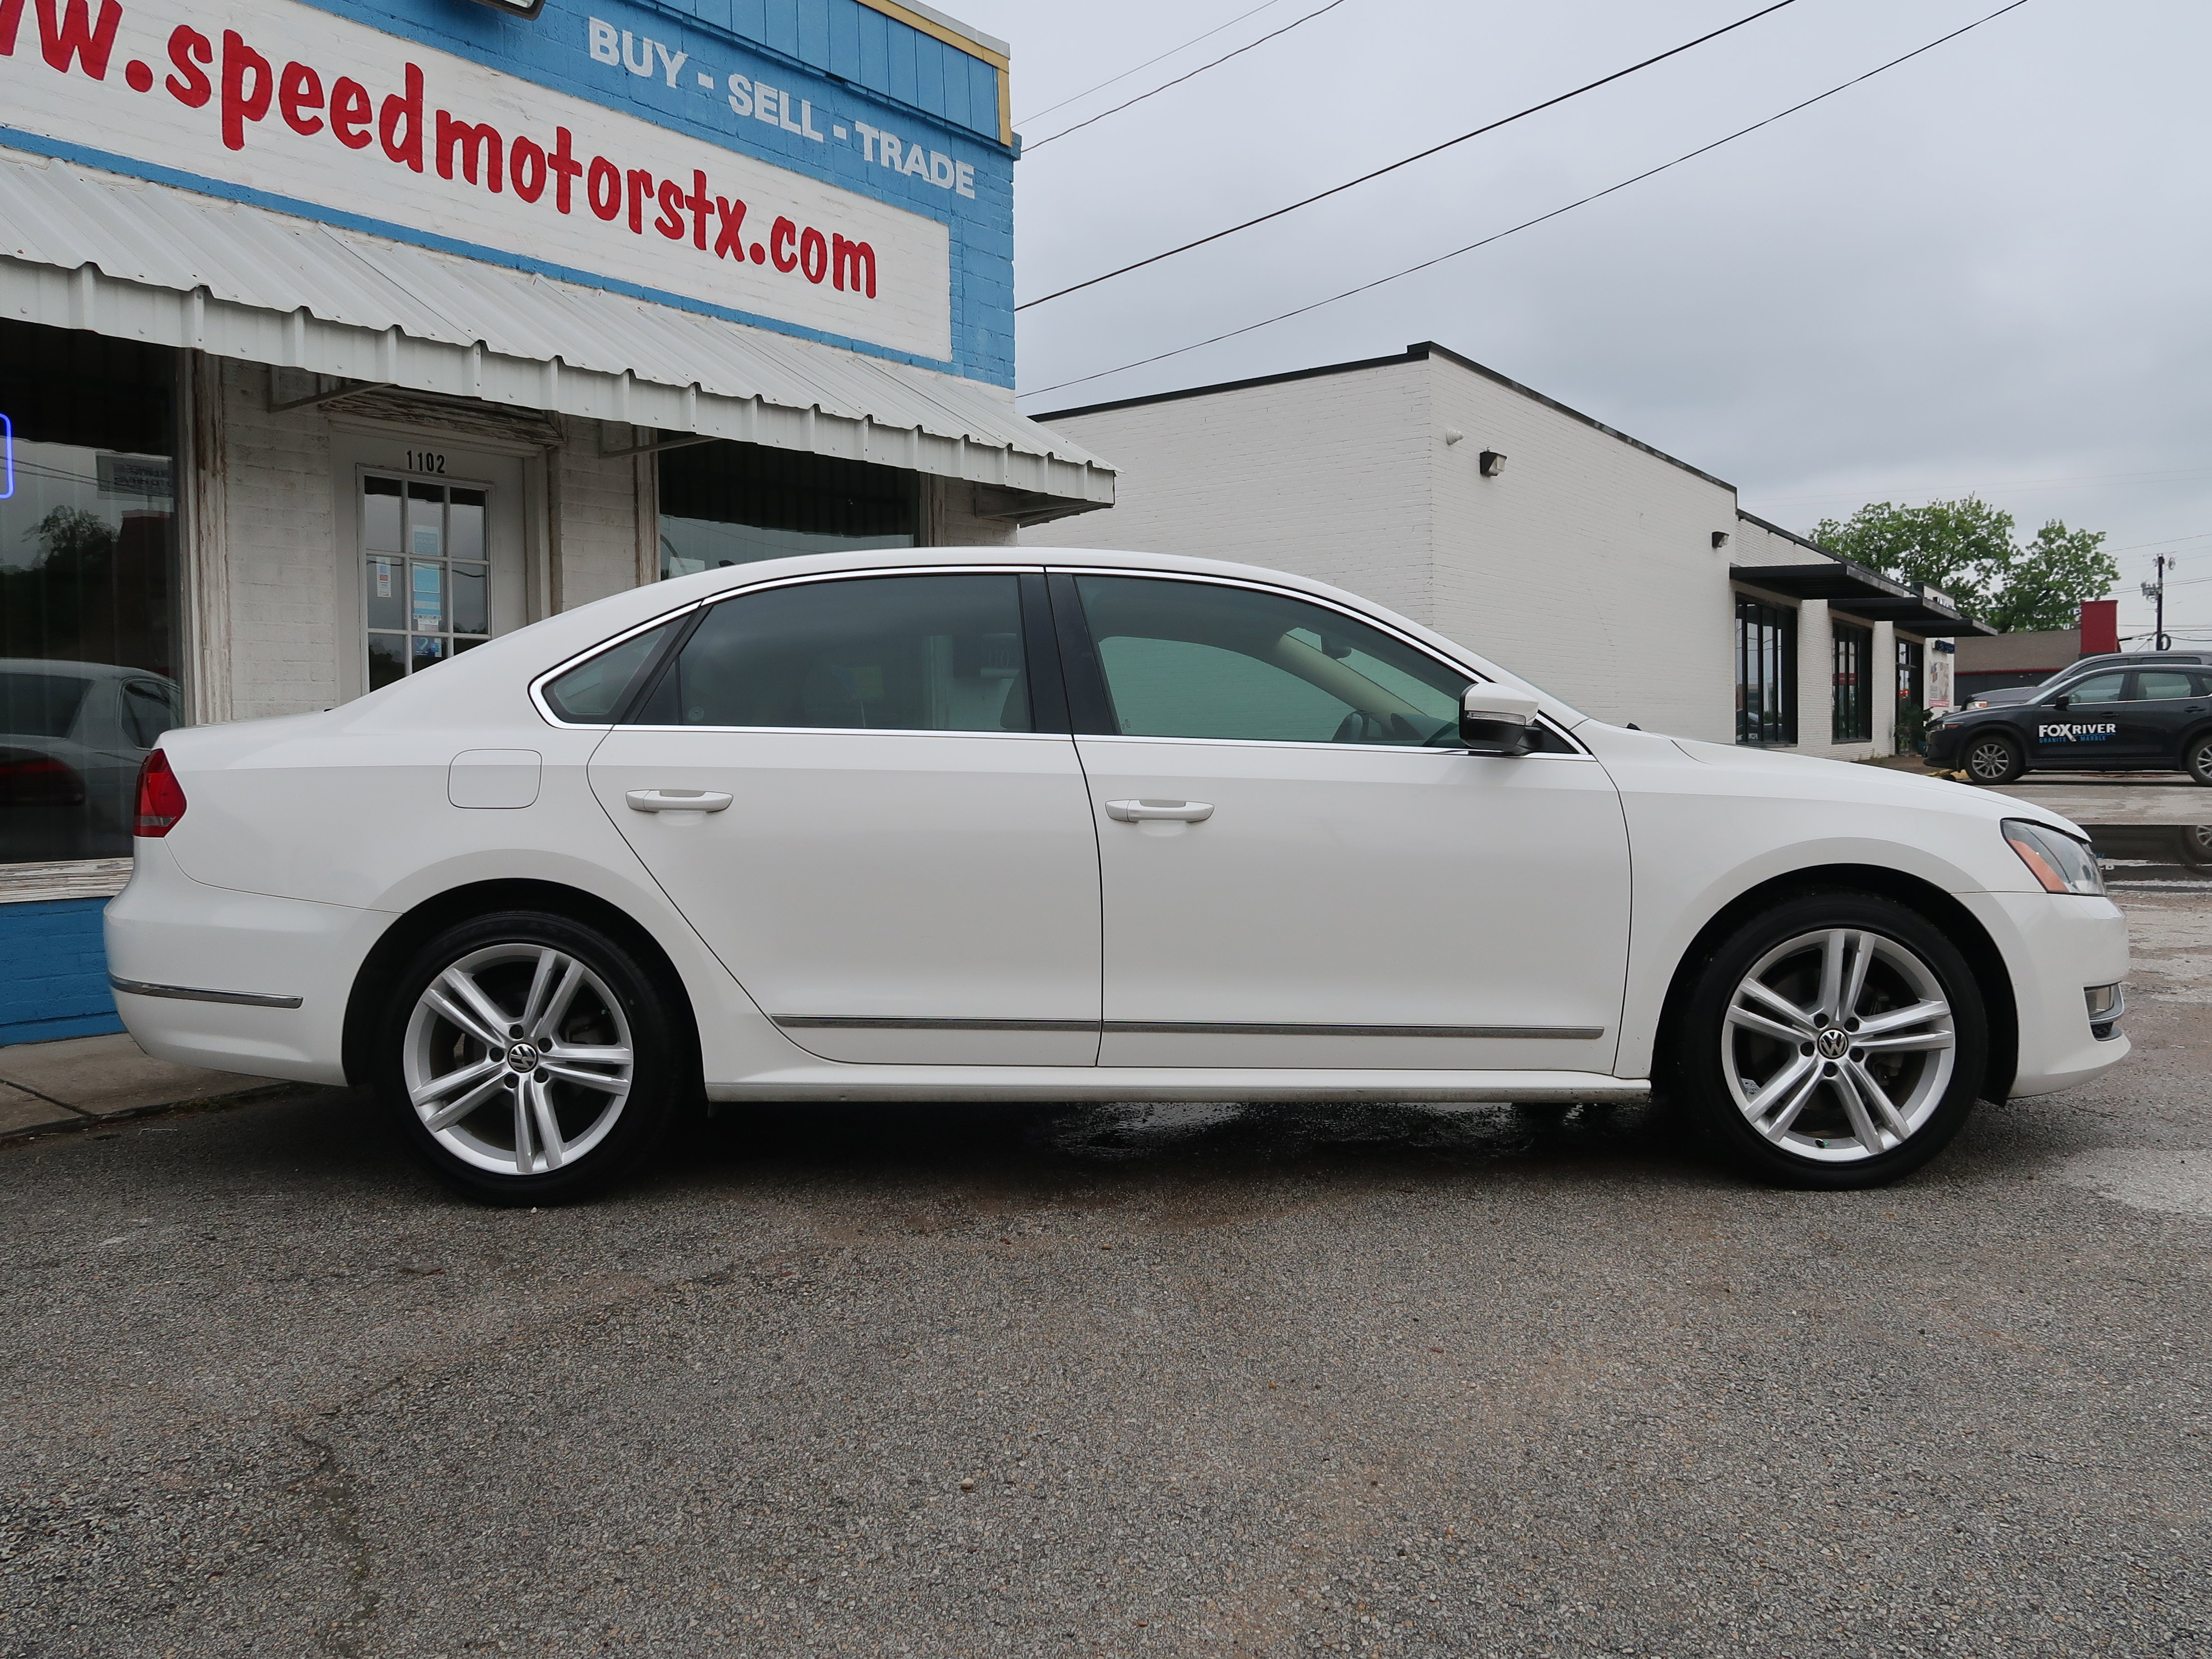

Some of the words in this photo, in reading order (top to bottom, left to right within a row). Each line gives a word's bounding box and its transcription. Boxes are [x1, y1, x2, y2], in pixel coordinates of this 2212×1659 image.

[0, 0, 876, 299] w.speedmotorstx.com
[589, 16, 689, 89] BUY
[728, 74, 824, 143] SELL
[855, 121, 975, 199] TRADE
[407, 450, 445, 474] 1102
